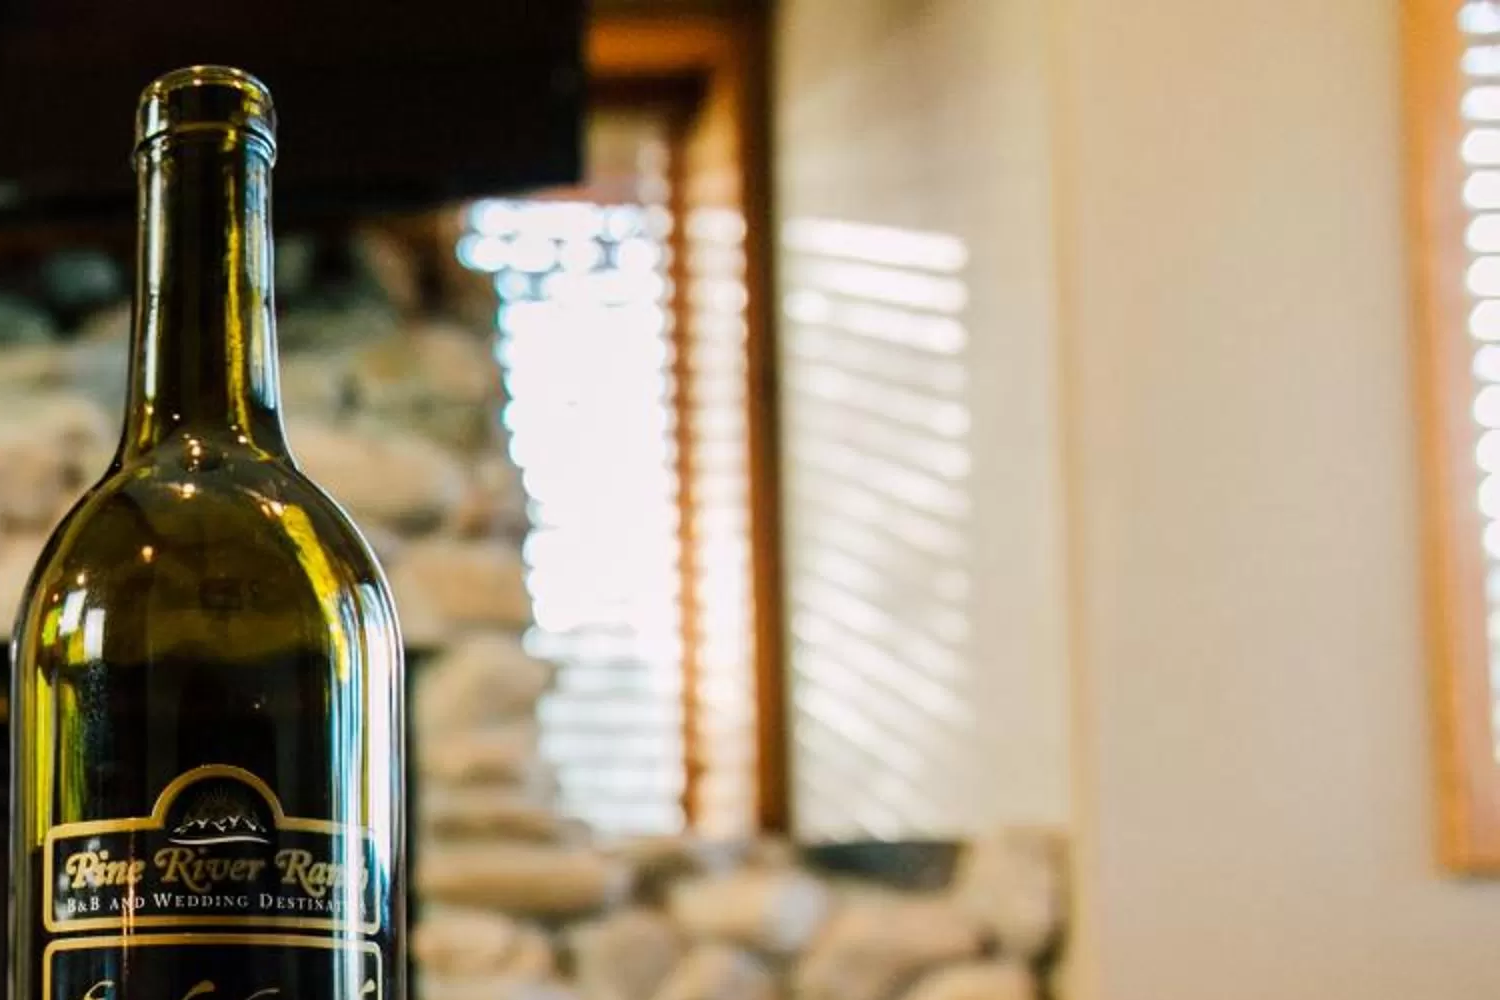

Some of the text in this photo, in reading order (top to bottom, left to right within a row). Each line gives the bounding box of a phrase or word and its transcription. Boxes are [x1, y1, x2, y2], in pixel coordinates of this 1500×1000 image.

[66, 847, 368, 898] Pine River Ranh
[67, 896, 100, 913] B&B
